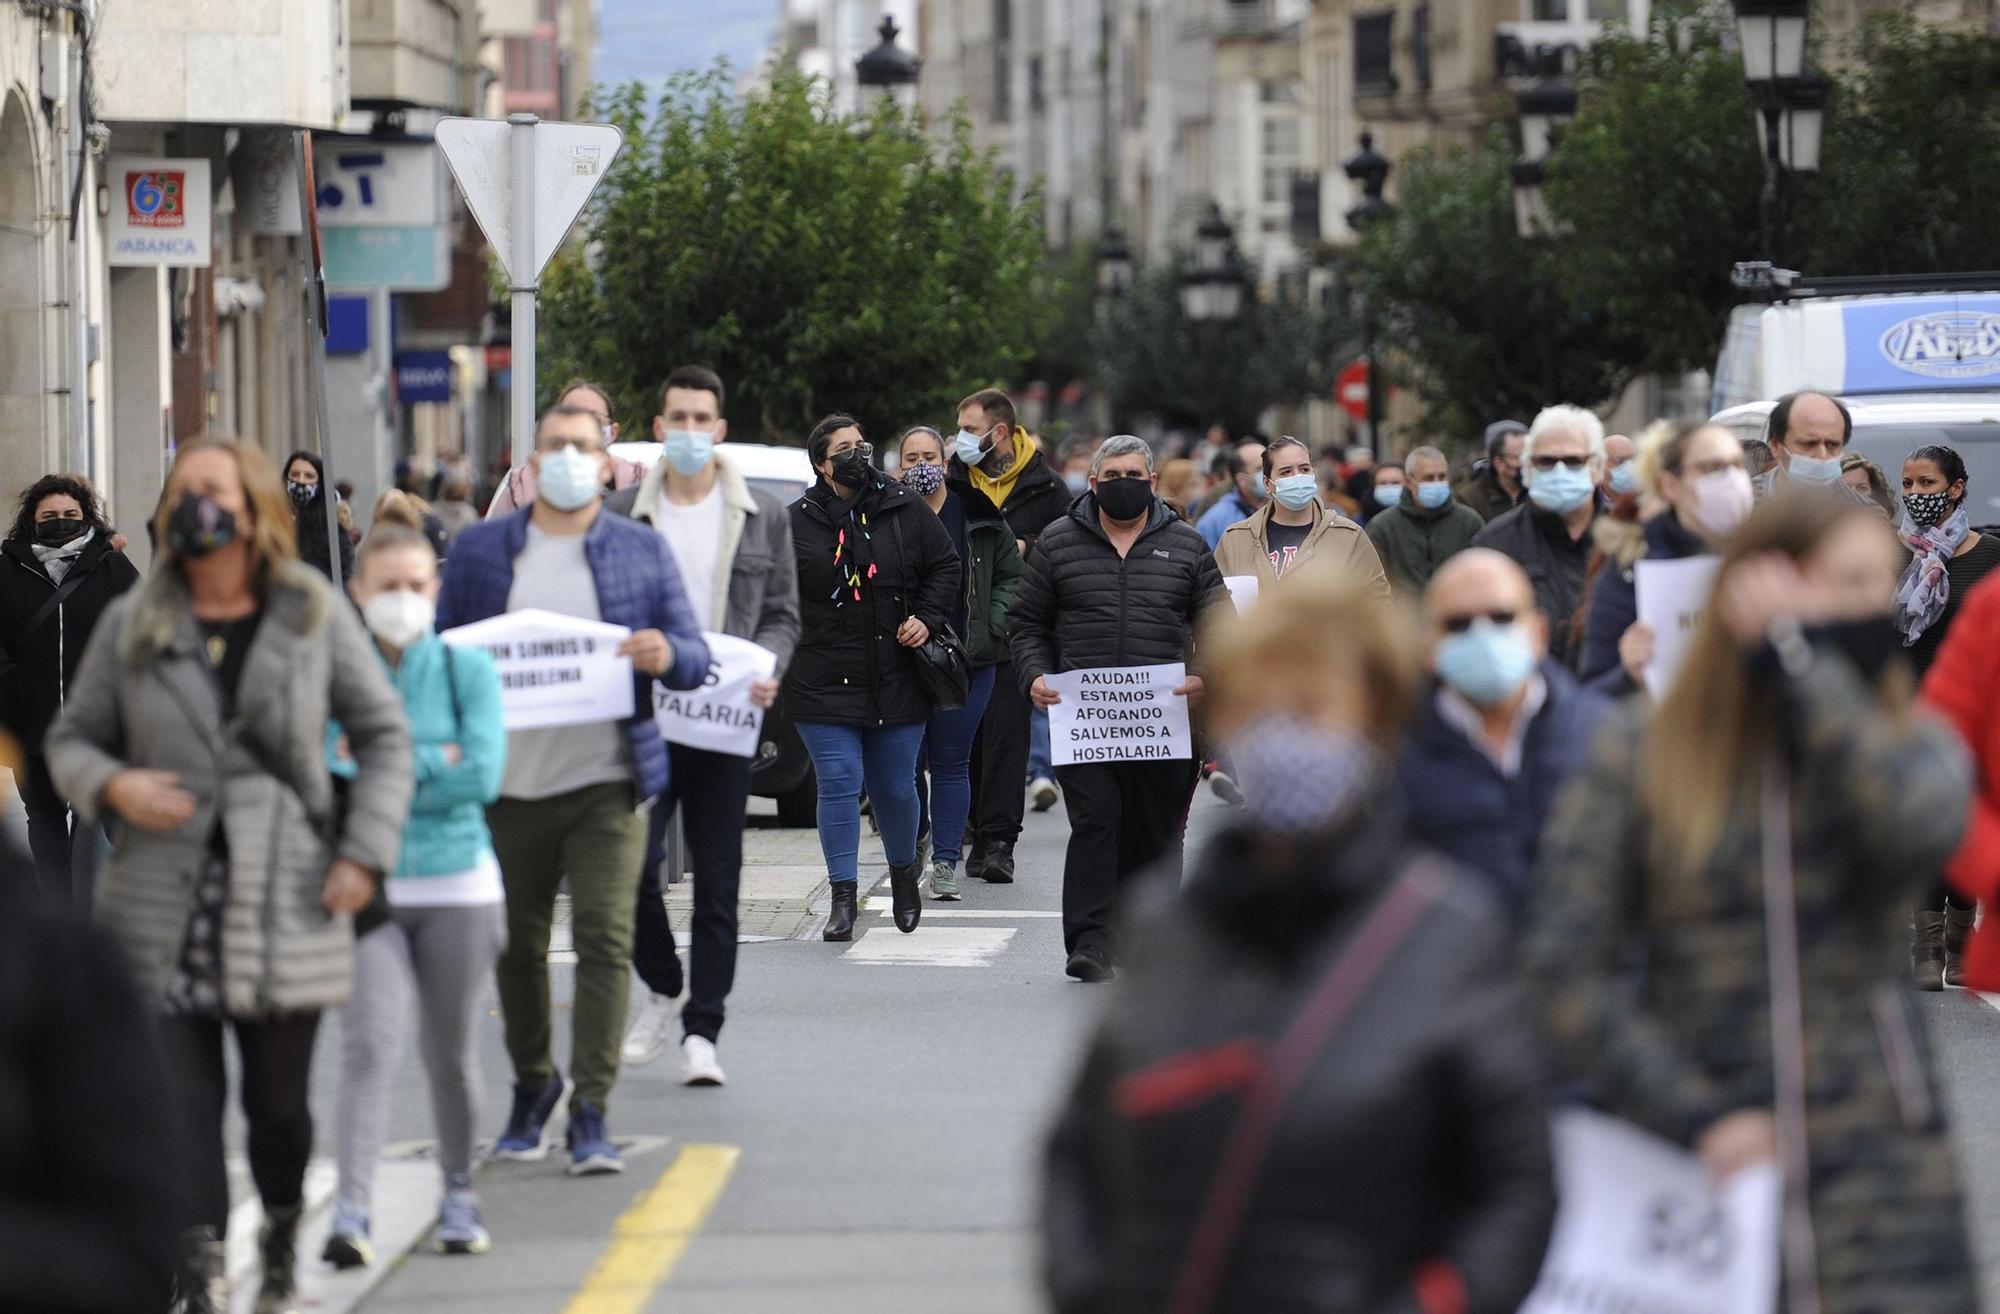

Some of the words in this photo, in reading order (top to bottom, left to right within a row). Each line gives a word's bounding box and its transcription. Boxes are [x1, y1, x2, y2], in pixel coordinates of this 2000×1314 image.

[115, 239, 196, 255] ABANCA
[518, 638, 579, 658] SOMOS
[584, 636, 596, 654] O
[500, 666, 582, 689] ROBLEMA
[1081, 672, 1150, 684] AXUDA!!!
[1080, 690, 1154, 702] ESTAMOS
[1076, 707, 1162, 720] AFOGANDO
[1070, 726, 1155, 741] SALVEMOS
[1160, 726, 1171, 737] A
[1073, 745, 1171, 761] HOSTALARIA
